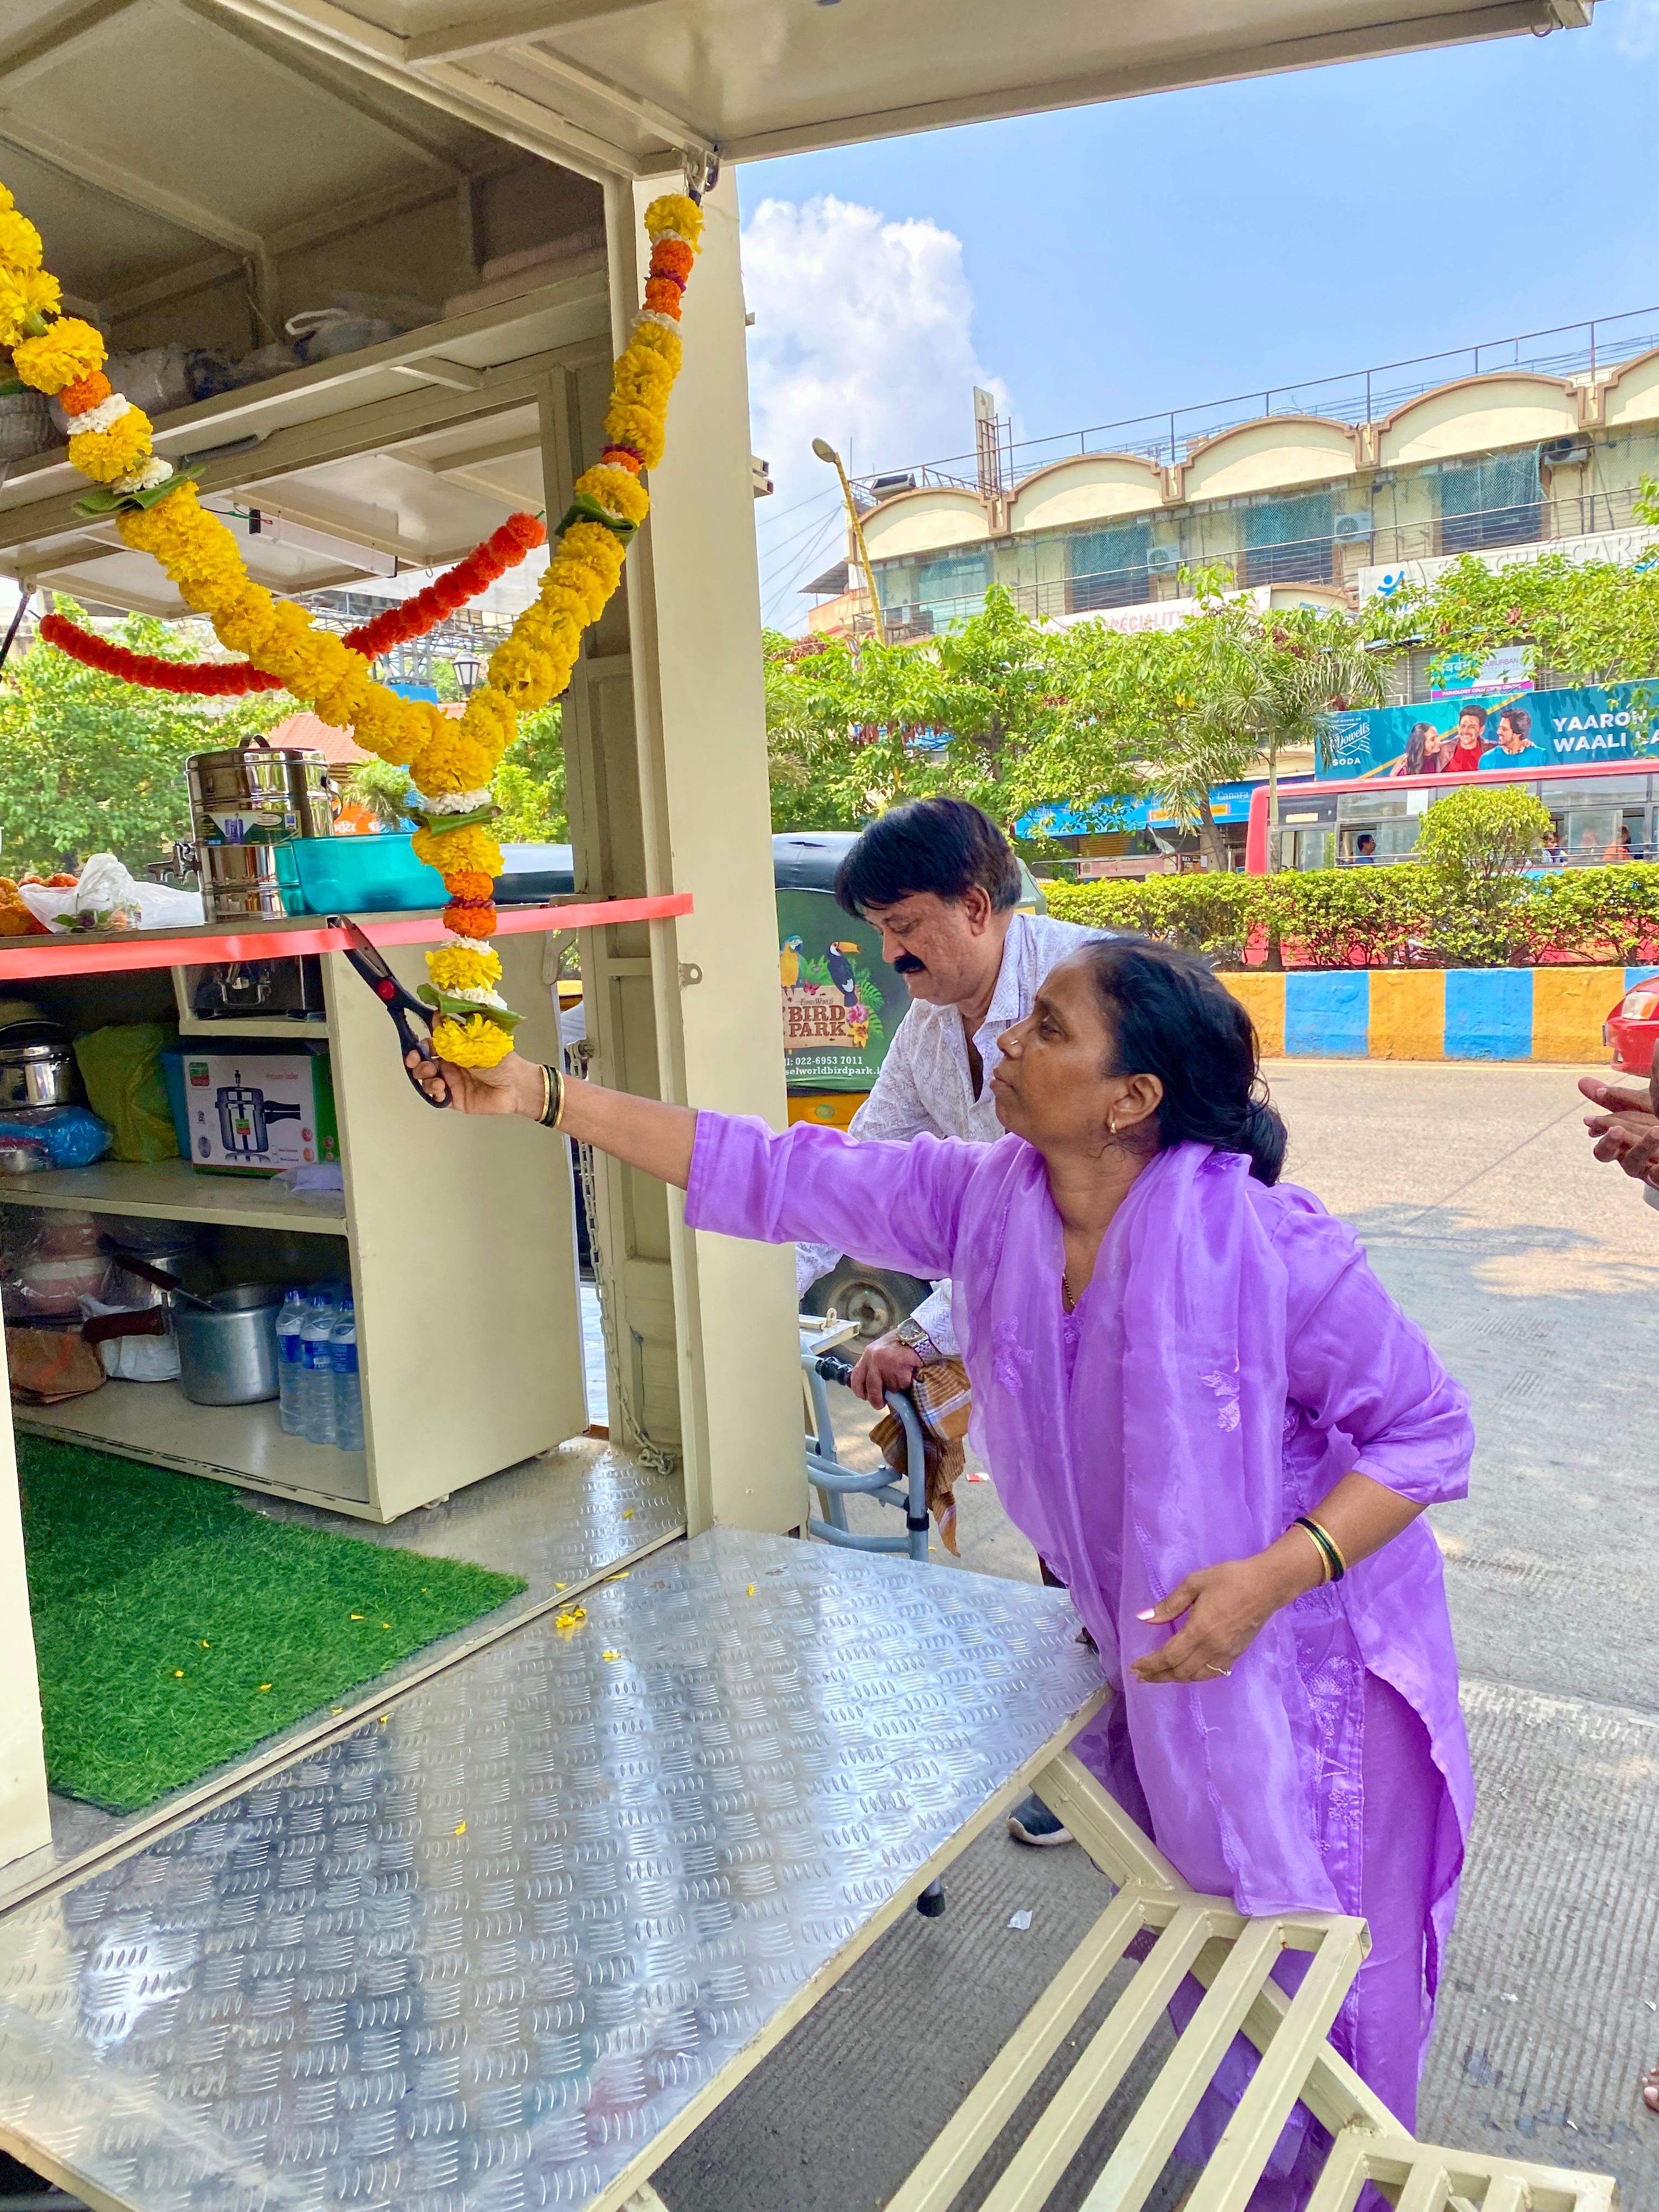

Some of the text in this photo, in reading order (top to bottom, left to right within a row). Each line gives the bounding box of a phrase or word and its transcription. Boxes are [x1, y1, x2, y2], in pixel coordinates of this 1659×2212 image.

[1482, 658, 1519, 667] SUBURBAN
[1553, 709, 1647, 732] YAARON
[1329, 721, 1370, 752] Dowell's
[1553, 732, 1627, 753] WAALI
[1332, 757, 1361, 766] SODA
[1217, 791, 1249, 800] Canara
[788, 1005, 845, 1023] BIRD
[788, 1022, 847, 1037] PARK
[795, 1056, 838, 1065] 022-6953
[840, 1056, 862, 1065] 7011
[786, 1066, 879, 1076] selworldbirdpark.i
